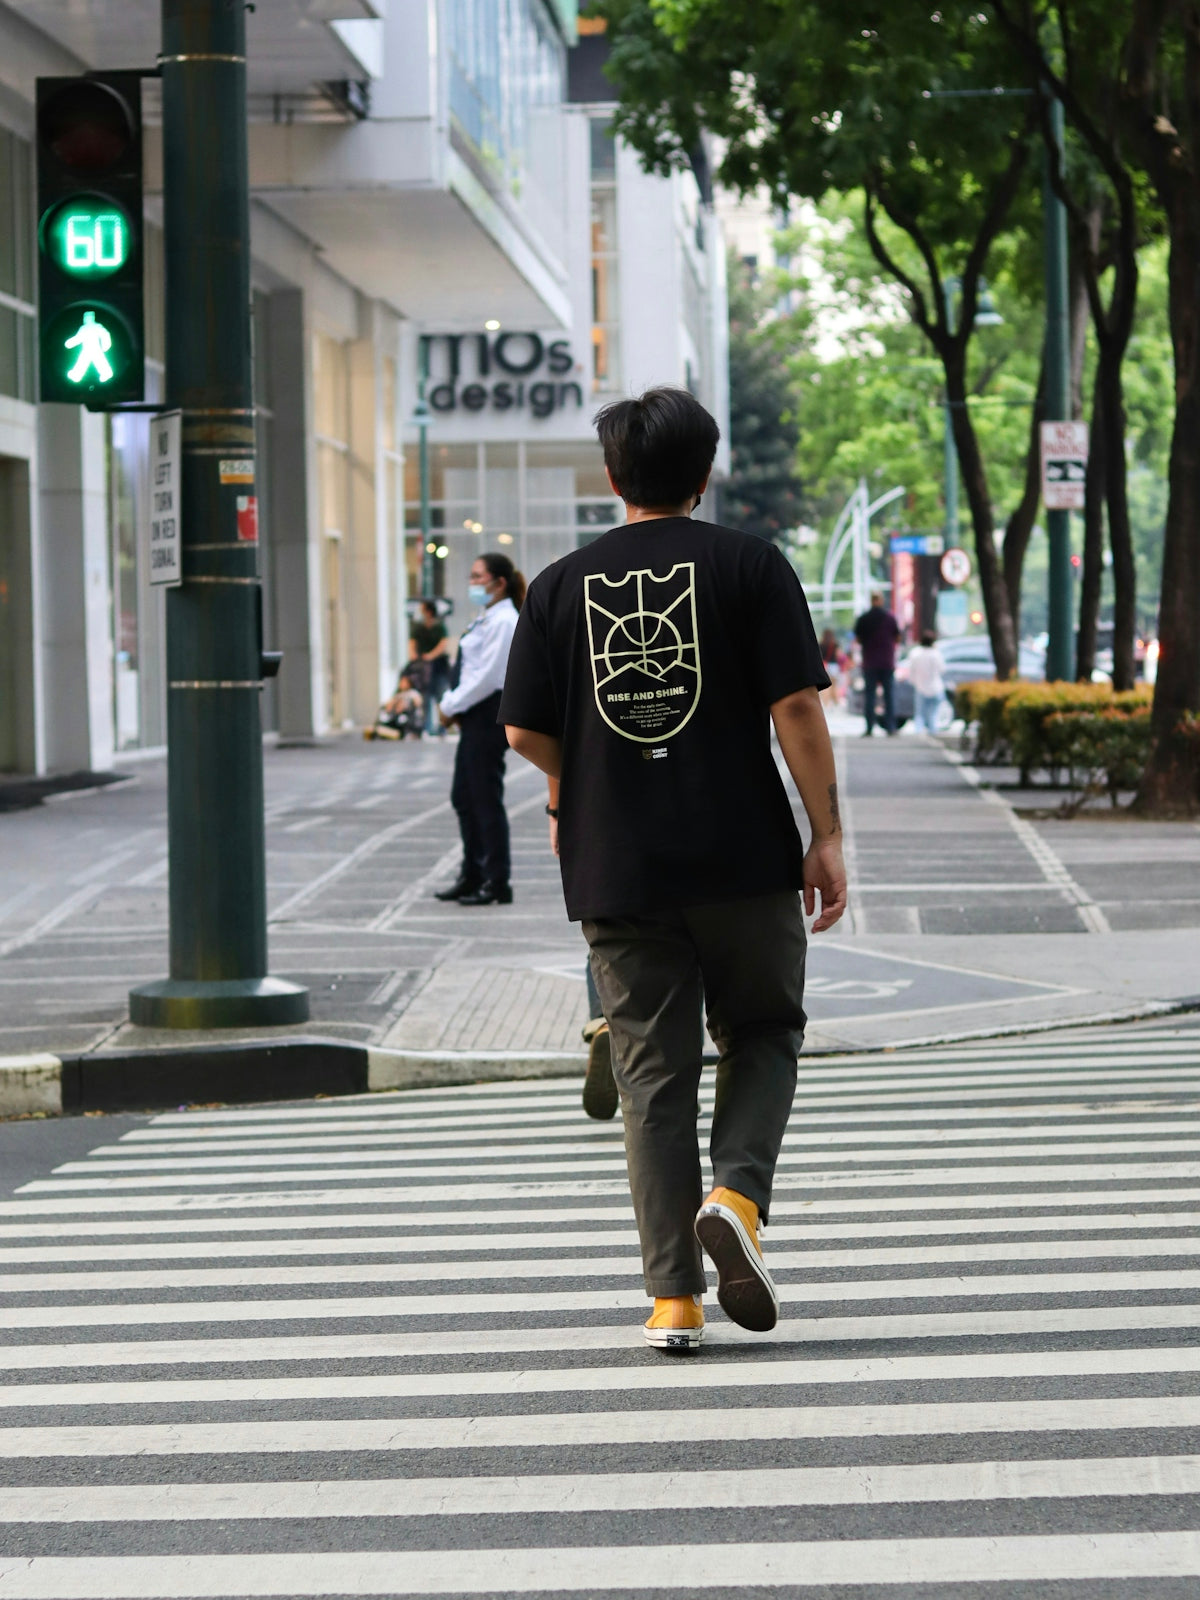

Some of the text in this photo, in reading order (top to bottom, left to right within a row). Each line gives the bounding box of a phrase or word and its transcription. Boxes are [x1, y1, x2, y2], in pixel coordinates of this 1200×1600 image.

[67, 215, 122, 267] 60
[430, 377, 582, 418] design
[155, 462, 171, 485] LEFT
[154, 491, 172, 512] TURN
[162, 518, 175, 539] RED
[152, 546, 176, 569] SIGNAL
[607, 686, 688, 702] RISE AND SHINE.
